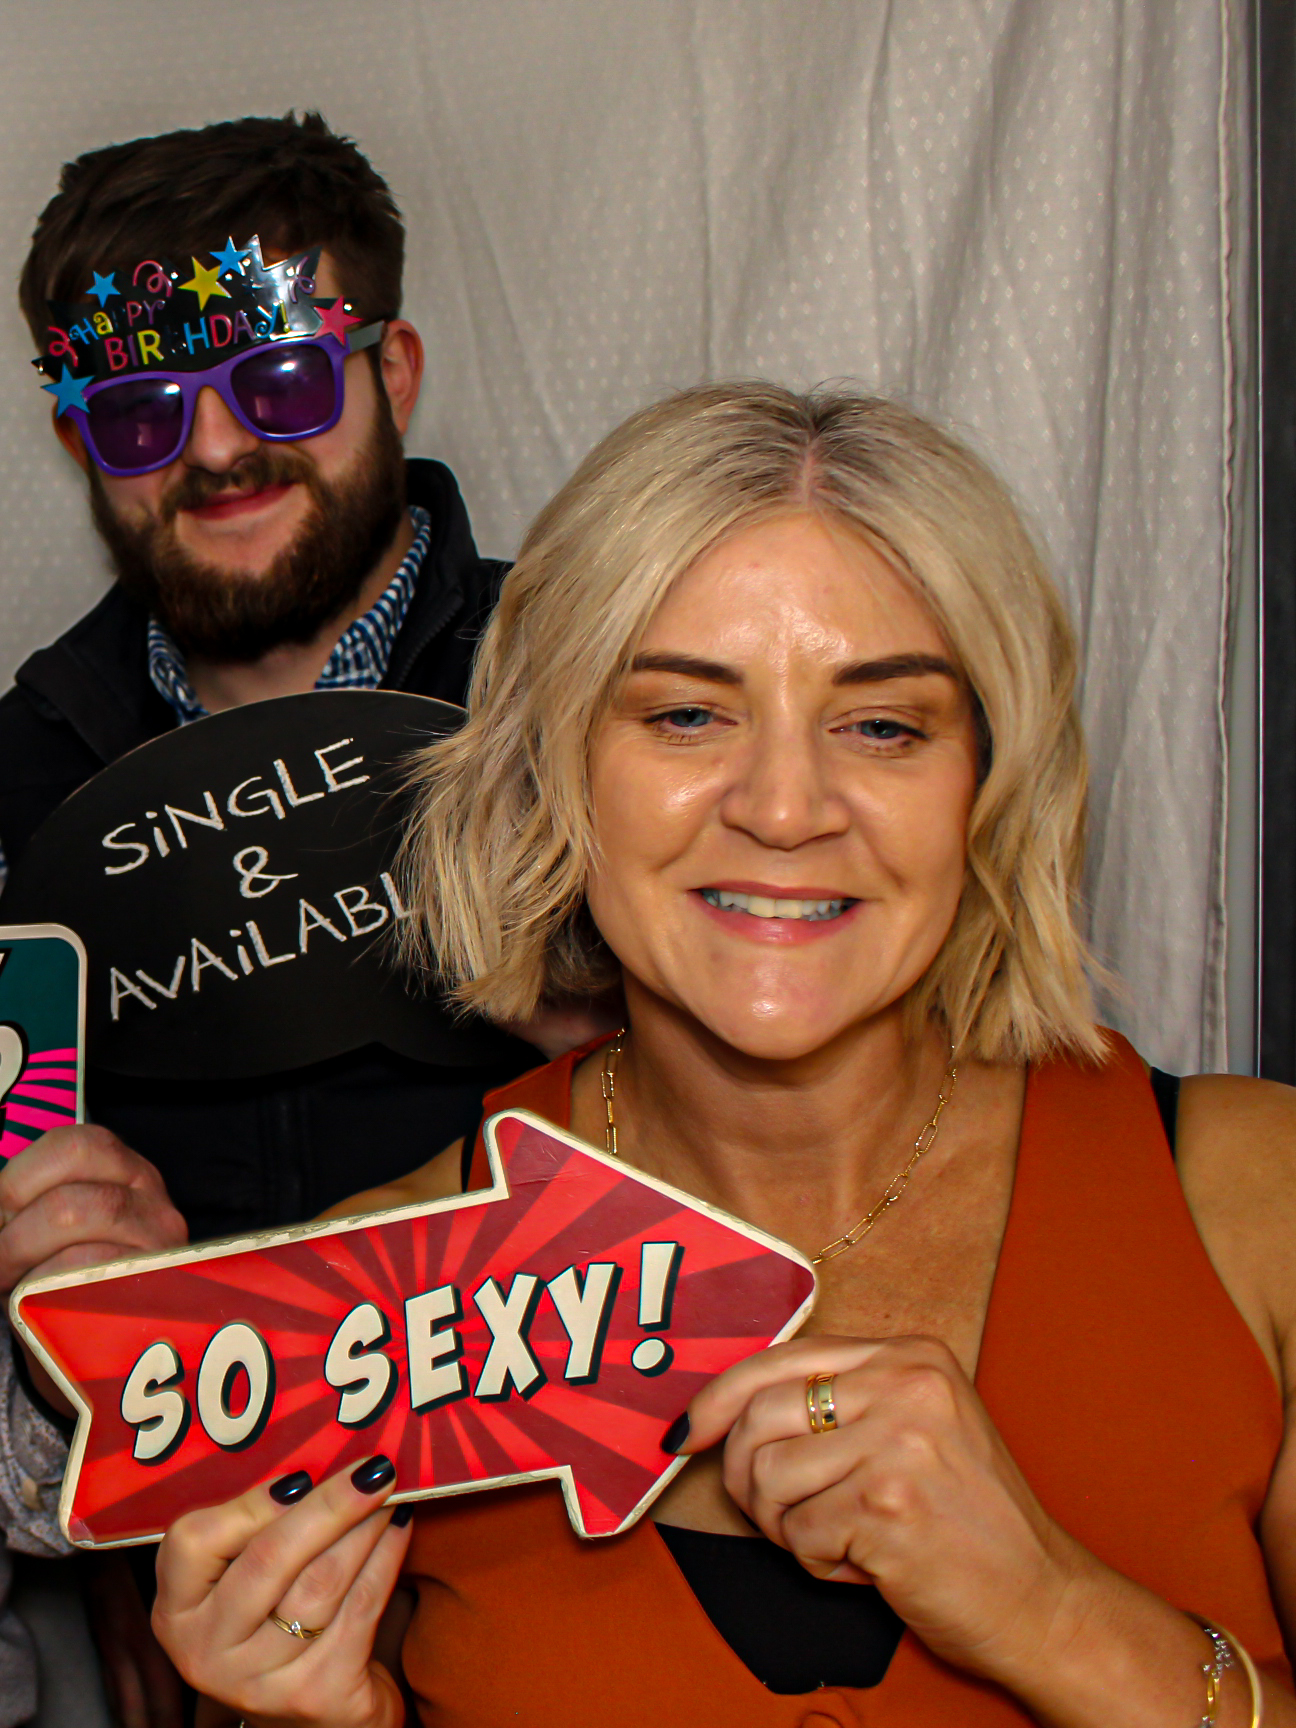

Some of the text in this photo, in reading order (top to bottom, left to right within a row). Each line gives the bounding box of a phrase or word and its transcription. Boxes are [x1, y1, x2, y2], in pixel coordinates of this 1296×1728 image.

[232, 845, 298, 898] &
[119, 1240, 681, 1463] SO SEXY!
